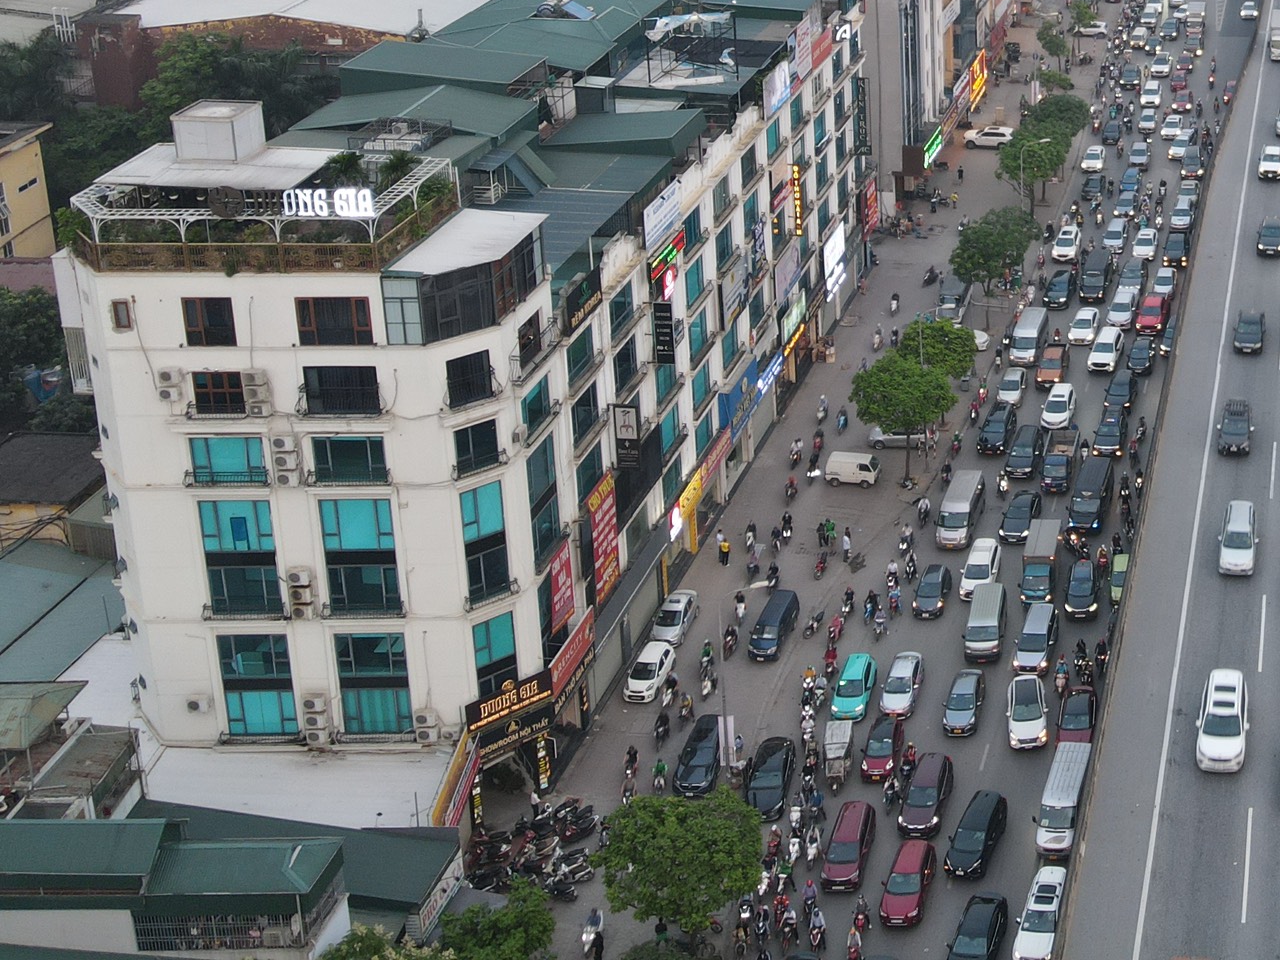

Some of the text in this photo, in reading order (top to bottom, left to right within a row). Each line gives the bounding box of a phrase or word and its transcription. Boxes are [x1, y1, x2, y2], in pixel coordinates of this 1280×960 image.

[334, 187, 375, 217] GIA
[520, 680, 539, 699] GIA
[479, 733, 519, 757] SHOWROOM
